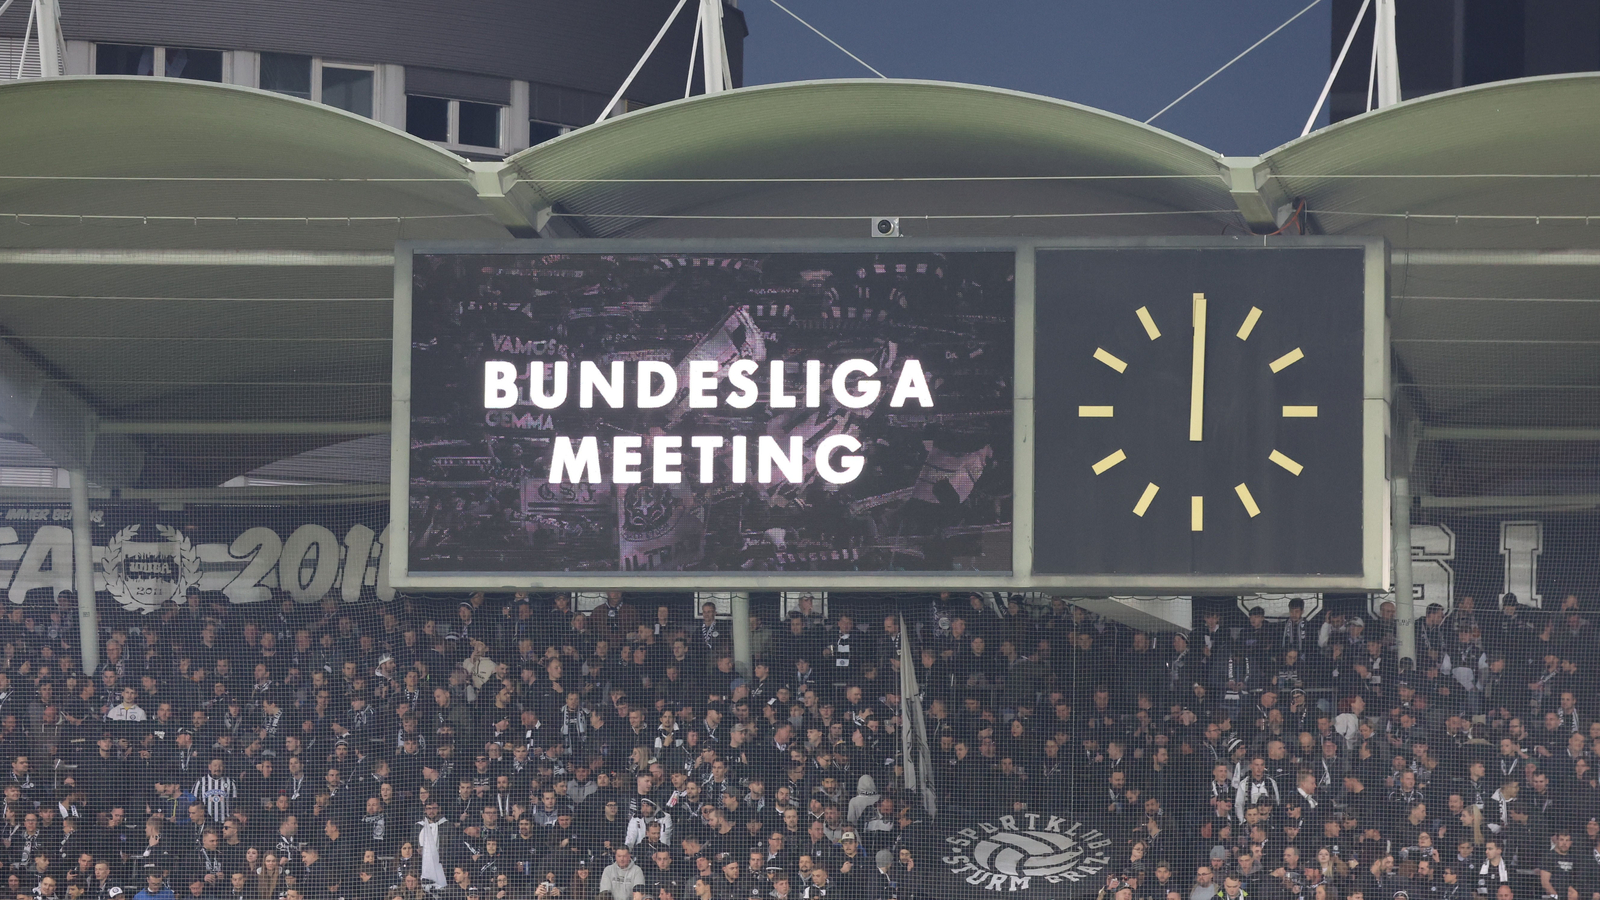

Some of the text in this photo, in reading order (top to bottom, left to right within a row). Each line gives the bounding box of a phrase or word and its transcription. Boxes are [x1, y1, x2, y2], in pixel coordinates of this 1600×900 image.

[491, 333, 557, 356] VAMOS
[484, 359, 934, 409] BUNDESLIGA
[485, 410, 554, 431] GEMMA
[548, 434, 865, 484] MEETING
[945, 813, 1112, 848] SPORTKLUB
[942, 855, 1111, 891] STURM GRAZ
